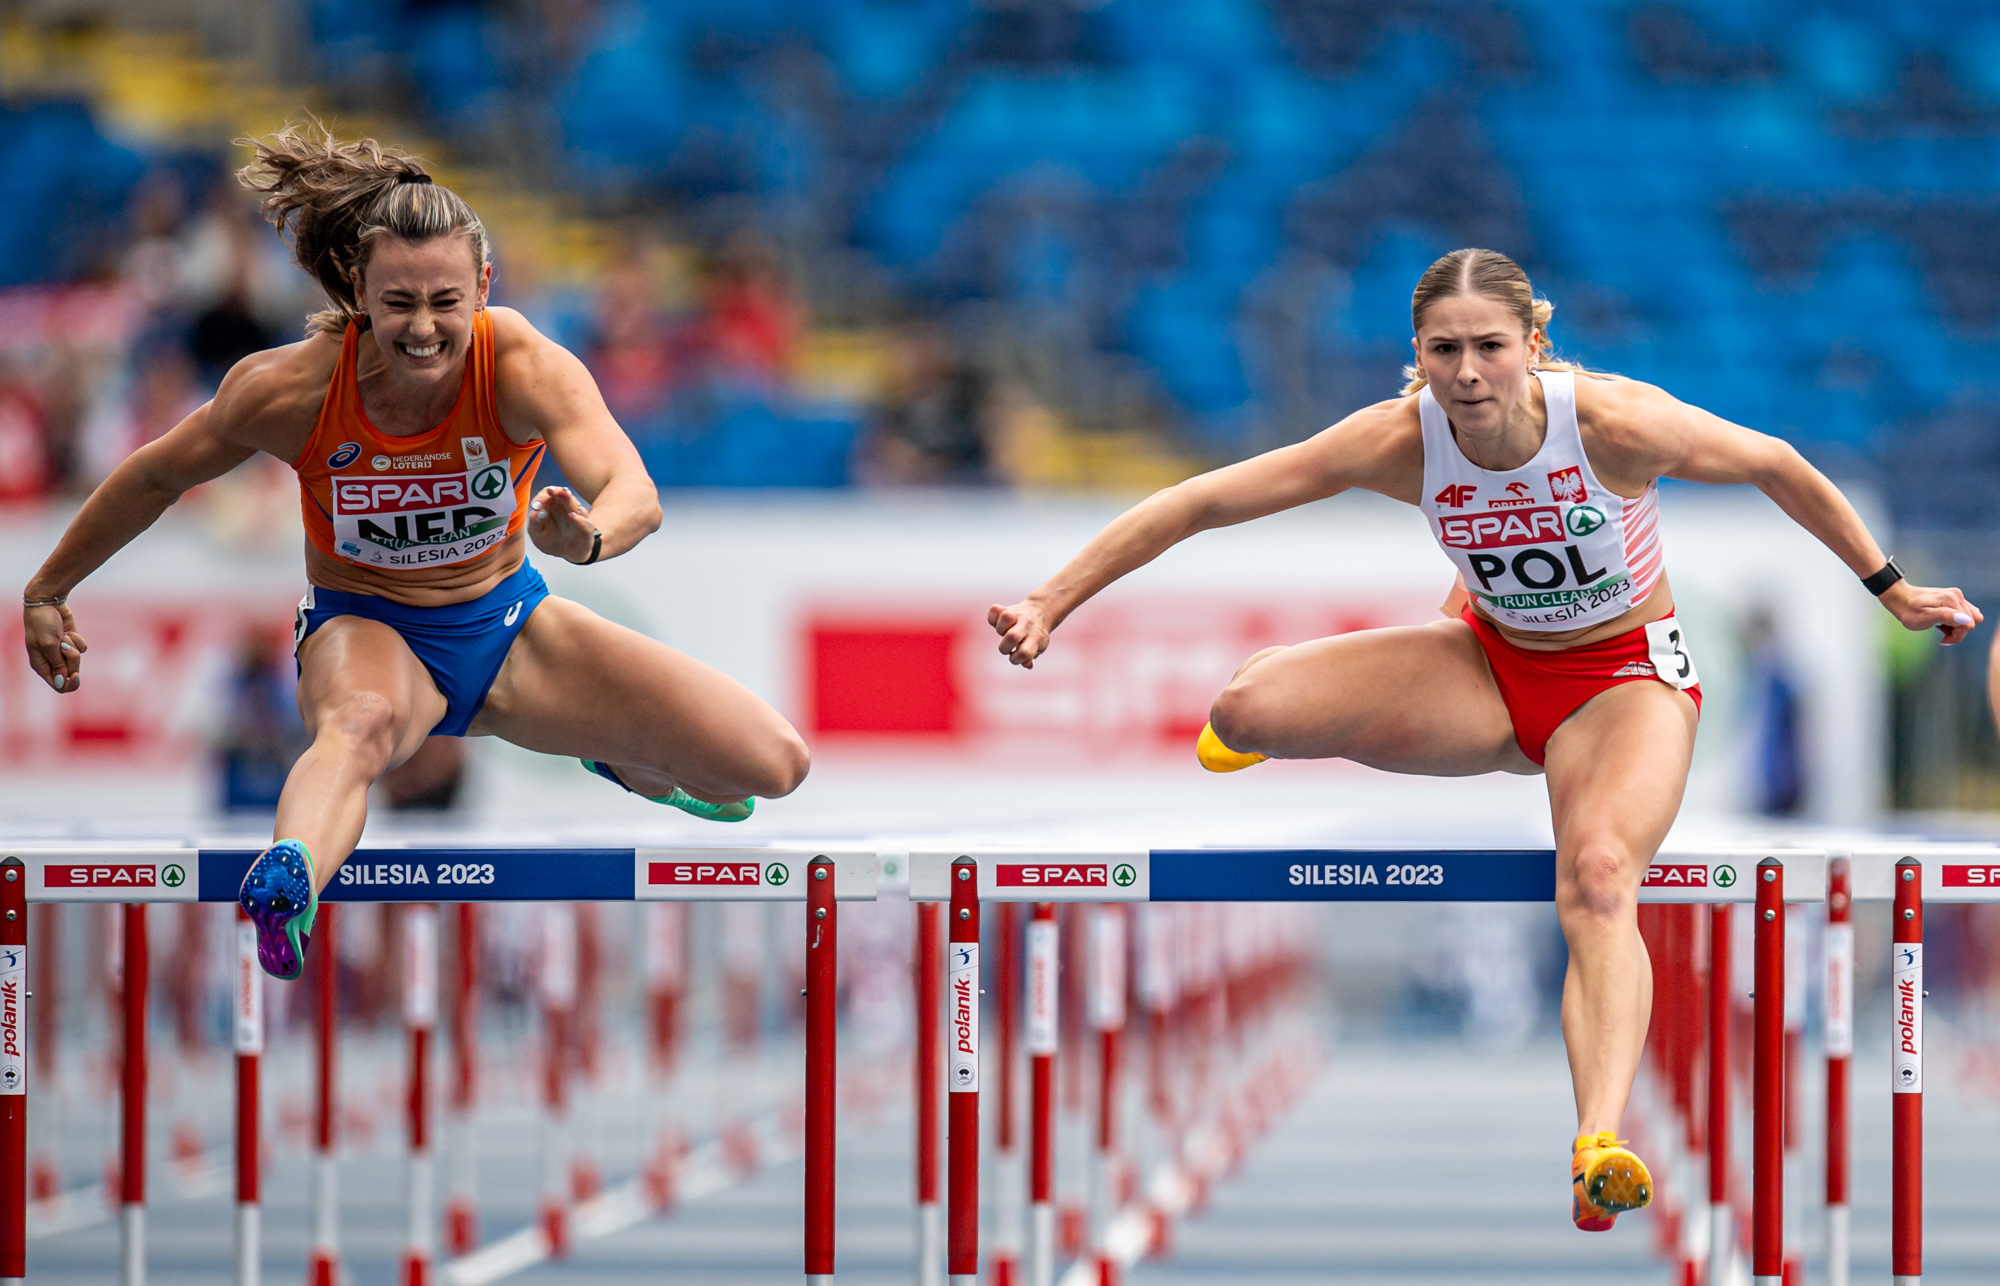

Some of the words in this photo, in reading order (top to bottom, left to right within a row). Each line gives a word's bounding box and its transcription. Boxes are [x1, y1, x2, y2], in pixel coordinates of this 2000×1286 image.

[393, 452, 452, 462] NEDERLANDSE
[393, 460, 432, 470] LOTERIJ
[341, 481, 465, 510] SPAR
[1435, 484, 1477, 508] 4F
[1445, 511, 1562, 545] SPAR
[390, 547, 460, 564] SILESIA
[1468, 544, 1607, 592] POL
[1504, 595, 1538, 607] RUN
[1588, 579, 1631, 609] 2023
[1669, 629, 1690, 678] 3
[70, 868, 154, 884] SPAR
[339, 864, 430, 885] SILESIA
[437, 864, 495, 885] 2023
[674, 866, 758, 882] SPAR
[1022, 867, 1106, 883] SPAR
[1288, 864, 1379, 885] SILESIA
[1386, 864, 1444, 885] 2023
[1644, 868, 1706, 884] PAR
[0, 980, 20, 1057] polanik
[954, 977, 974, 1055] polanik
[1898, 978, 1917, 1055] polanik
